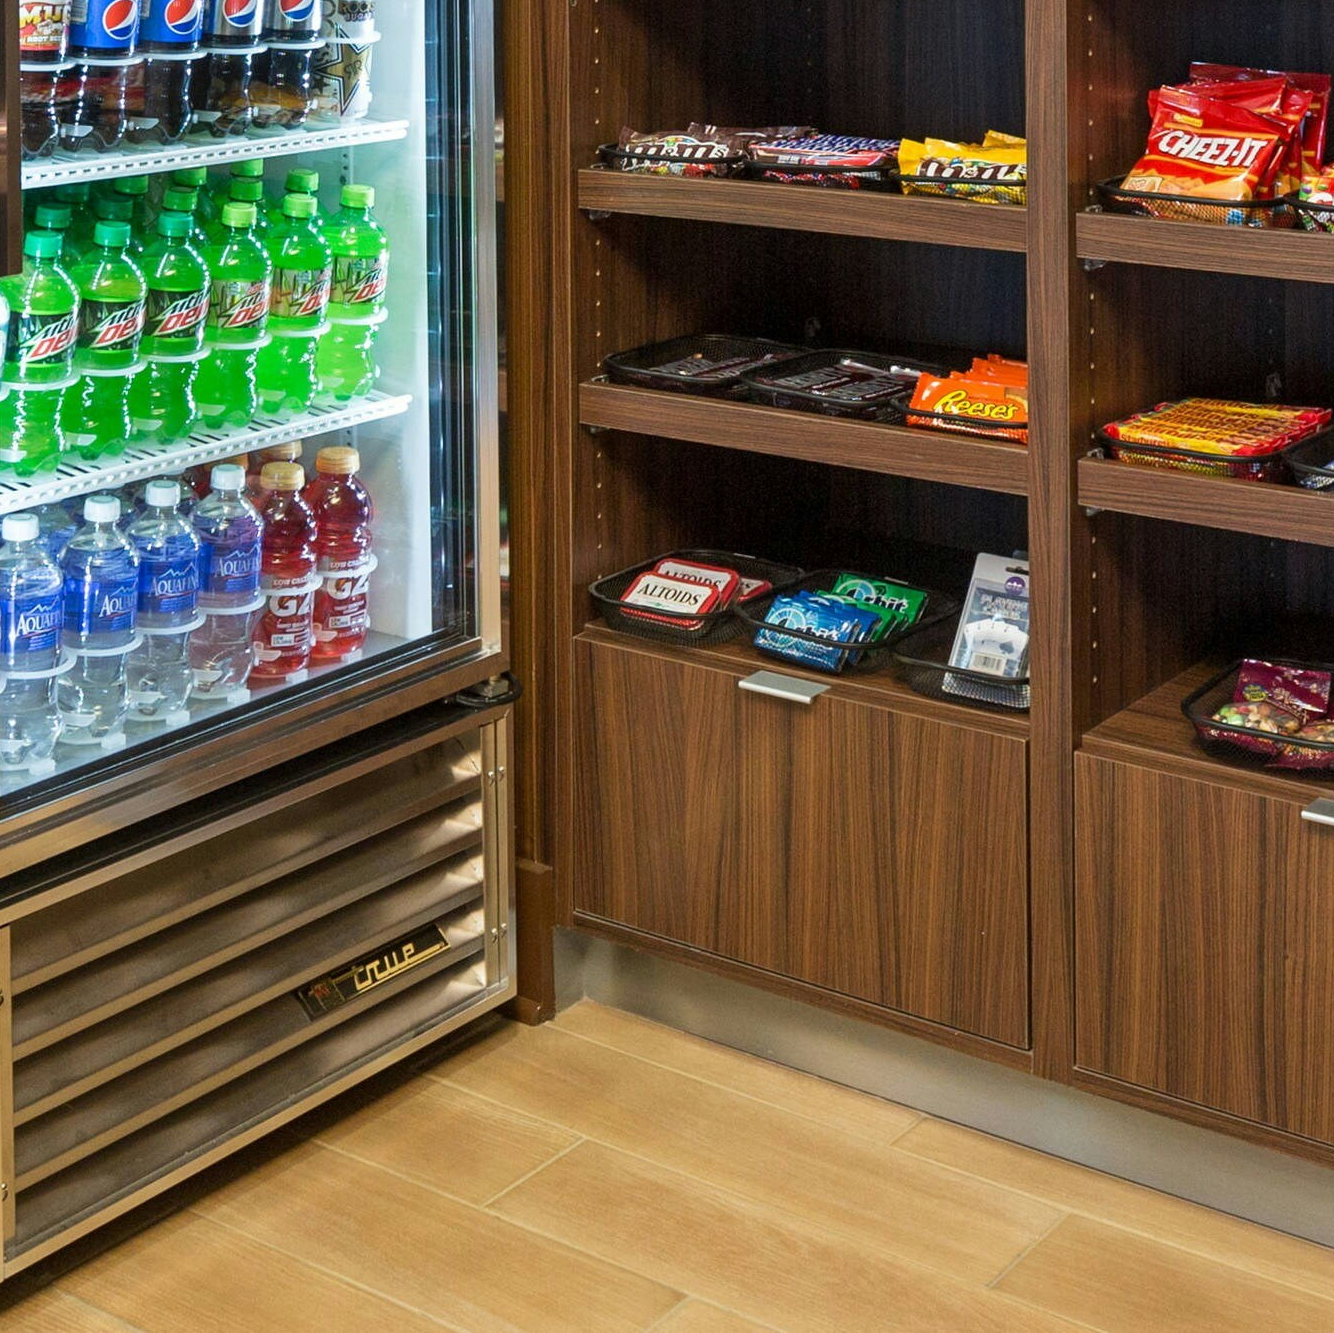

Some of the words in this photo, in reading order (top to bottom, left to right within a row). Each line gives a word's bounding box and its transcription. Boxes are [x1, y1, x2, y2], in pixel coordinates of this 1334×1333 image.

[1156, 130, 1267, 167] CHEEZ-IT
[932, 390, 1018, 420] Reese's
[327, 574, 369, 600] G2
[637, 583, 702, 606] ALTOIDS
